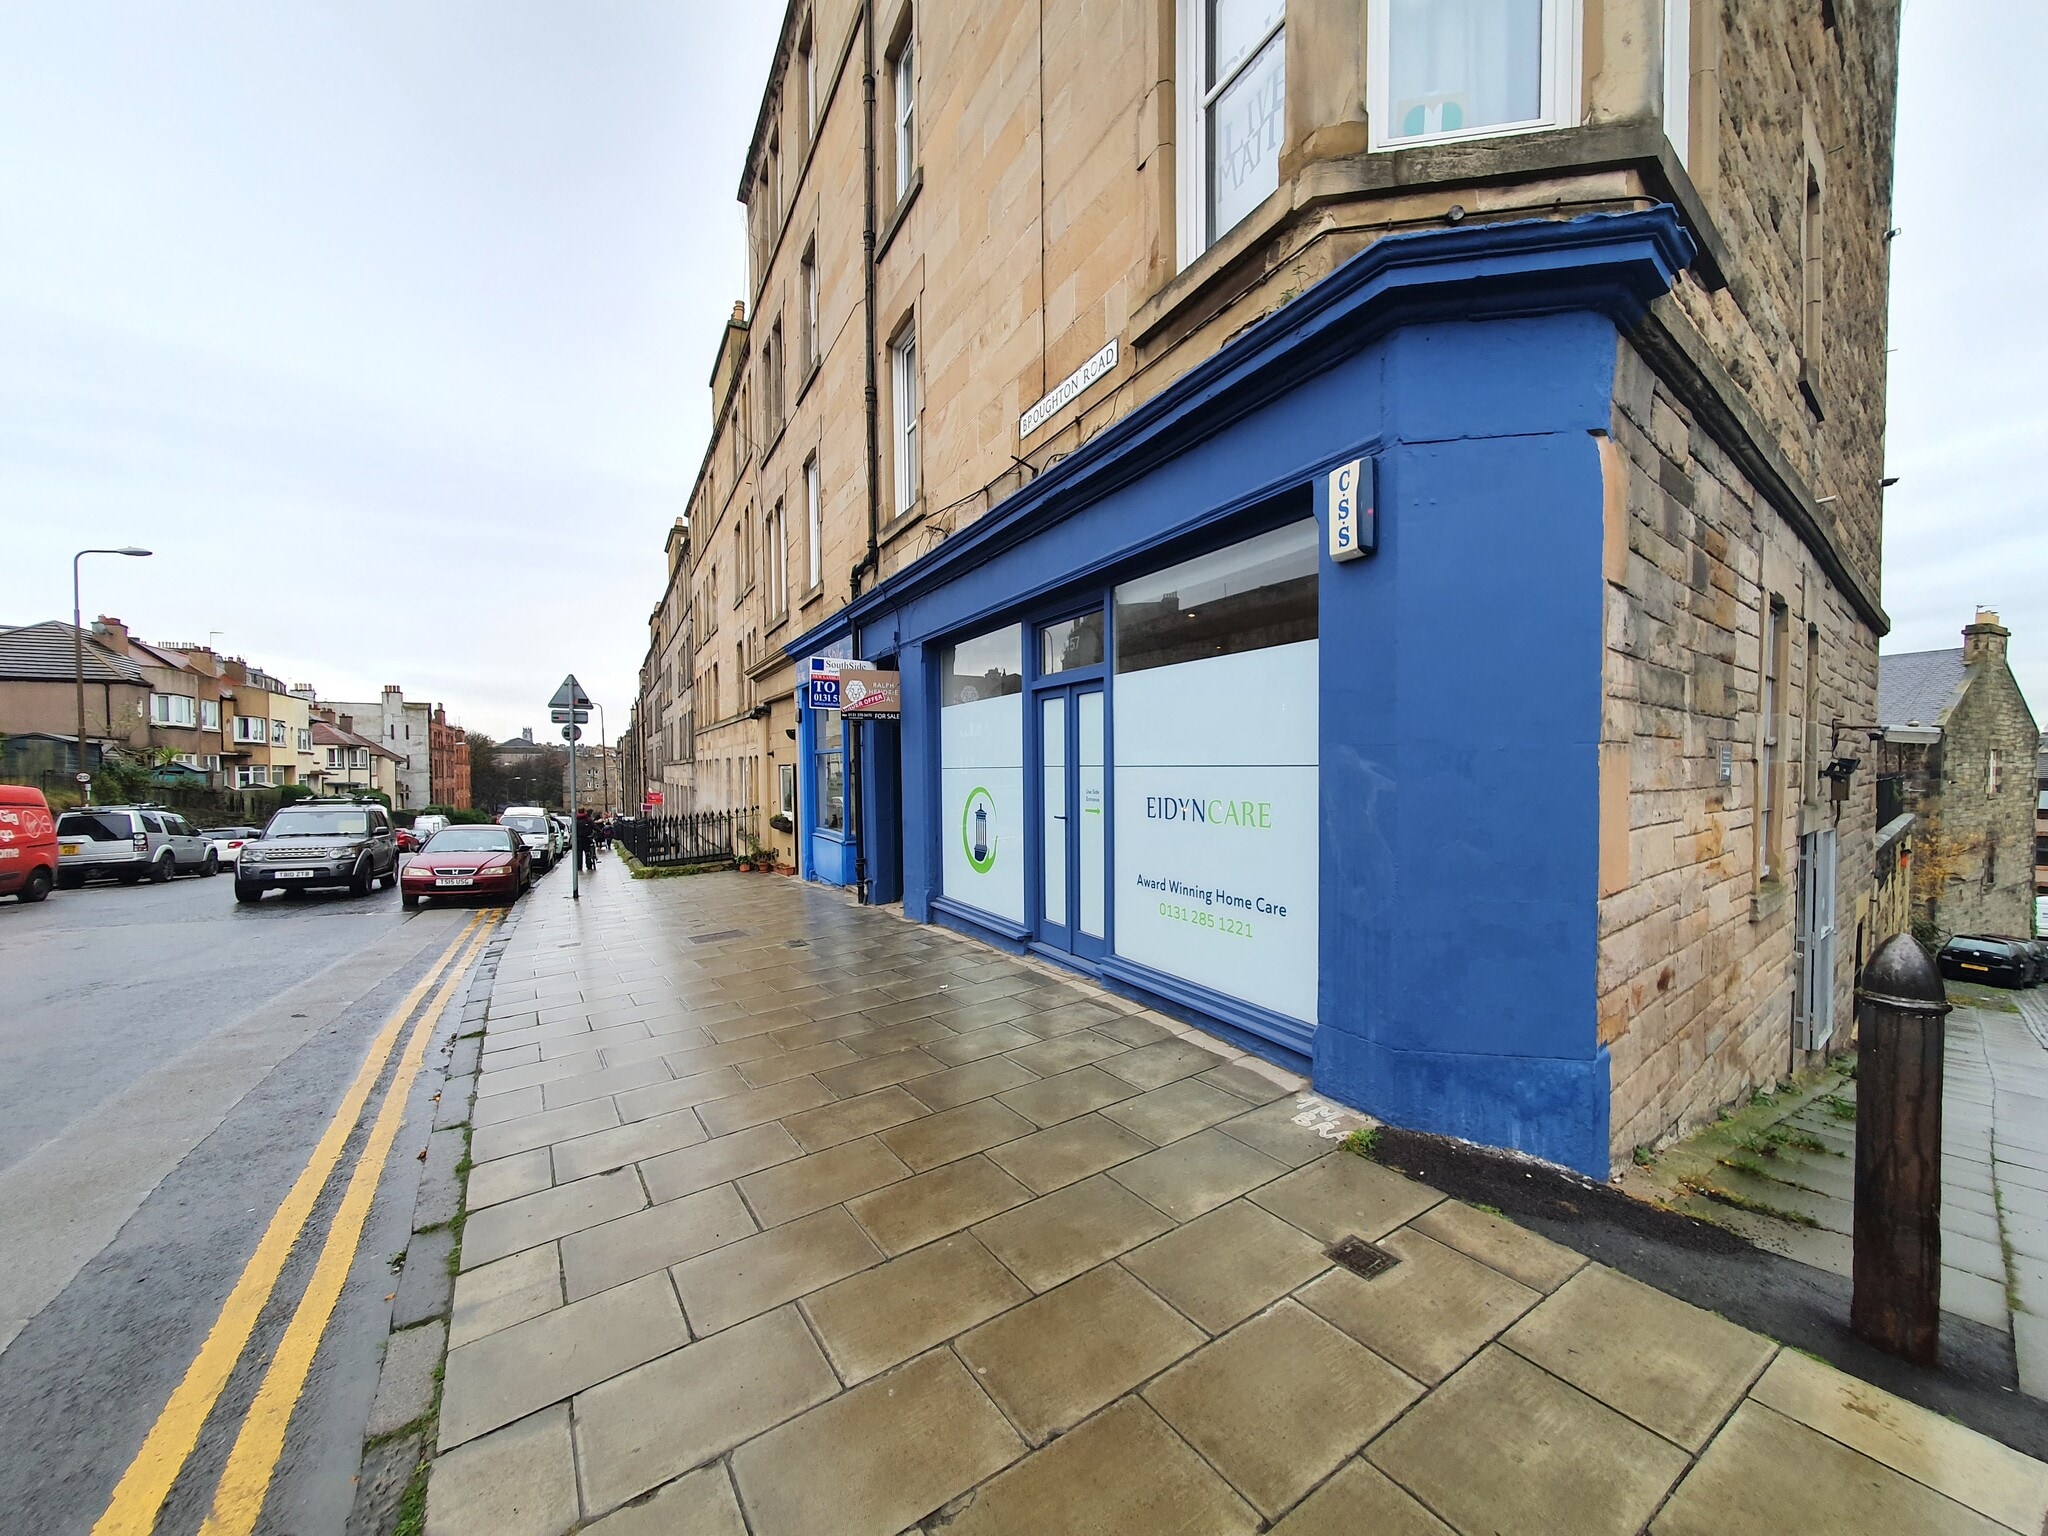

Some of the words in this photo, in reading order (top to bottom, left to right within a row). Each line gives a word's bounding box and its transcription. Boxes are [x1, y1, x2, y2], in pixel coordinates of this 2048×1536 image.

[1022, 375, 1079, 432] BROUGHTON
[1083, 348, 1114, 385] ROAD
[813, 680, 836, 693] TO
[813, 693, 831, 702] 0131
[863, 693, 883, 705] OFFER
[1146, 796, 1272, 829] EIDYNCARE
[1136, 873, 1166, 891] Award
[1168, 879, 1213, 905] Winning
[1216, 889, 1252, 910] Home
[1256, 897, 1287, 917] Care
[1159, 902, 1188, 922] 0131
[1191, 910, 1215, 928] 285
[1218, 917, 1253, 938] 1221
